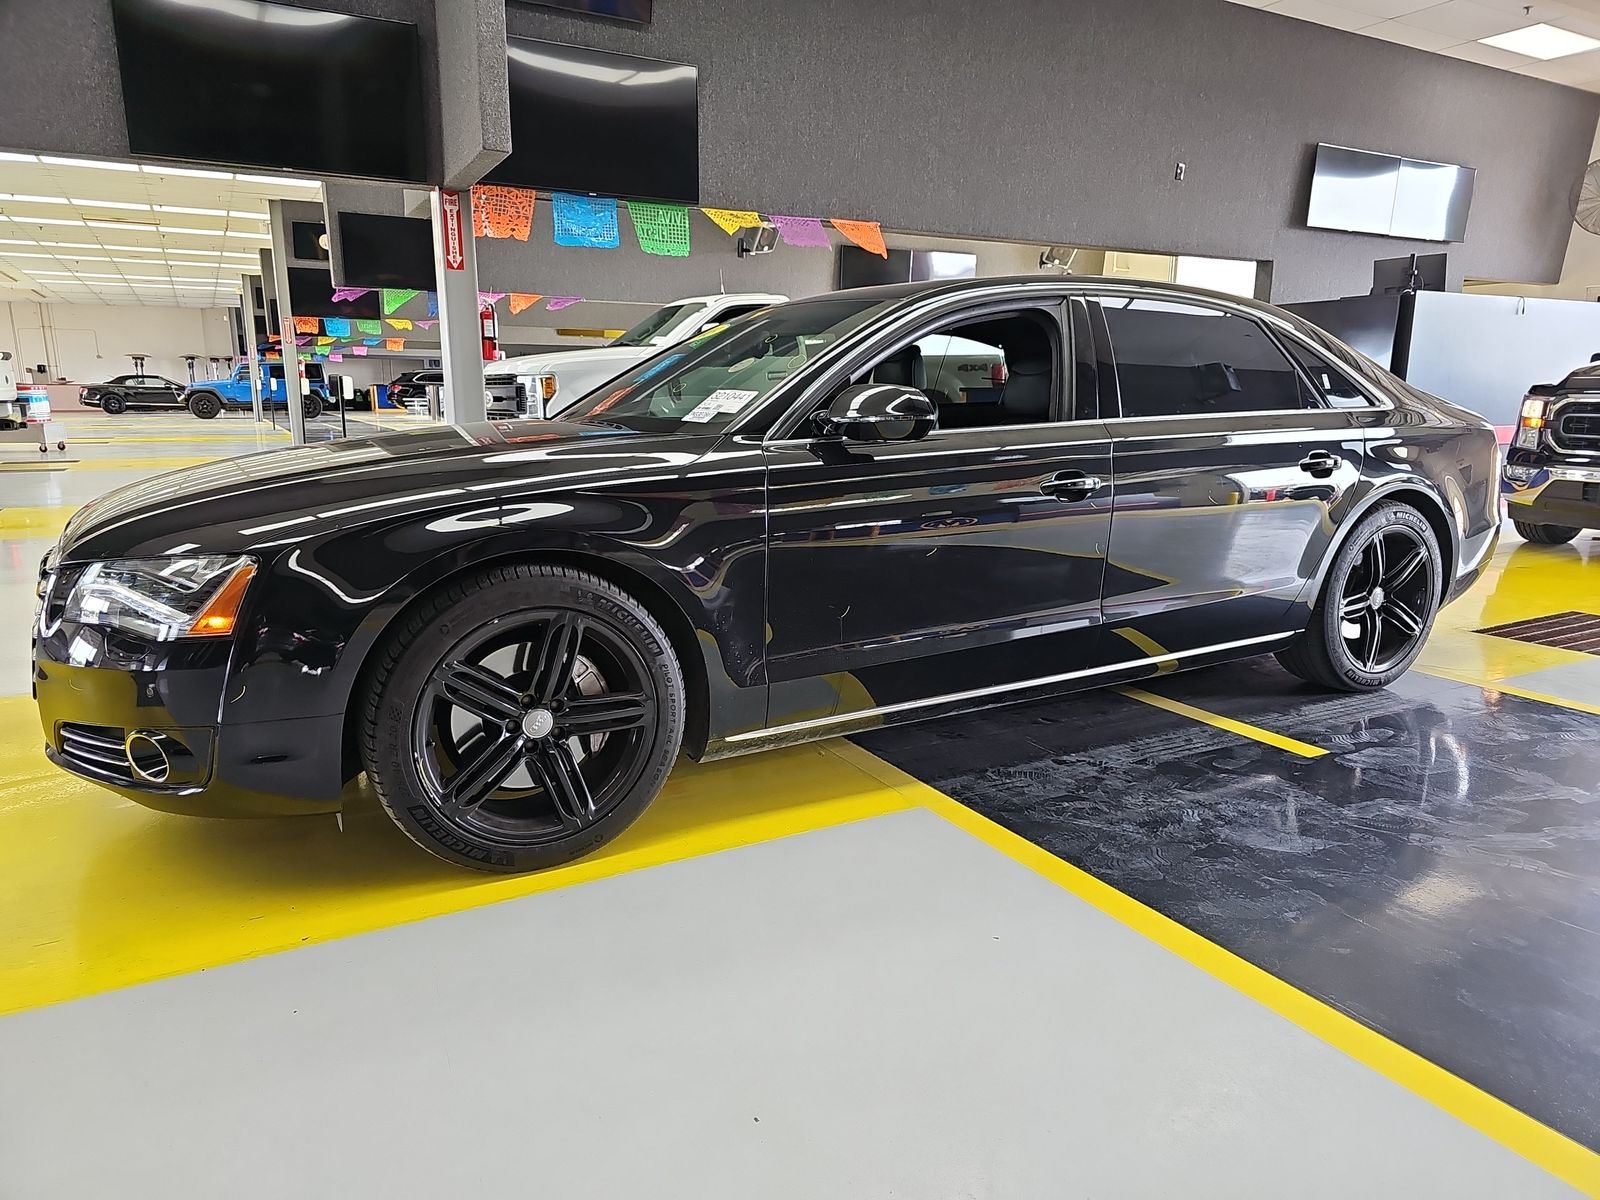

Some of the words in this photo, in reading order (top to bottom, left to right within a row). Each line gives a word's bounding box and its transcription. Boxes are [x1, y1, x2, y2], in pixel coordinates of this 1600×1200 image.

[444, 198, 457, 207] FIRE
[449, 208, 458, 264] EXTINGUISHER
[1396, 511, 1427, 531] MICHELIN
[599, 599, 663, 658] MICHELIN
[661, 663, 675, 690] PILOT
[669, 693, 677, 724] SPORT
[1346, 669, 1380, 686] MICHELIN
[410, 808, 490, 863] MICHELIN
